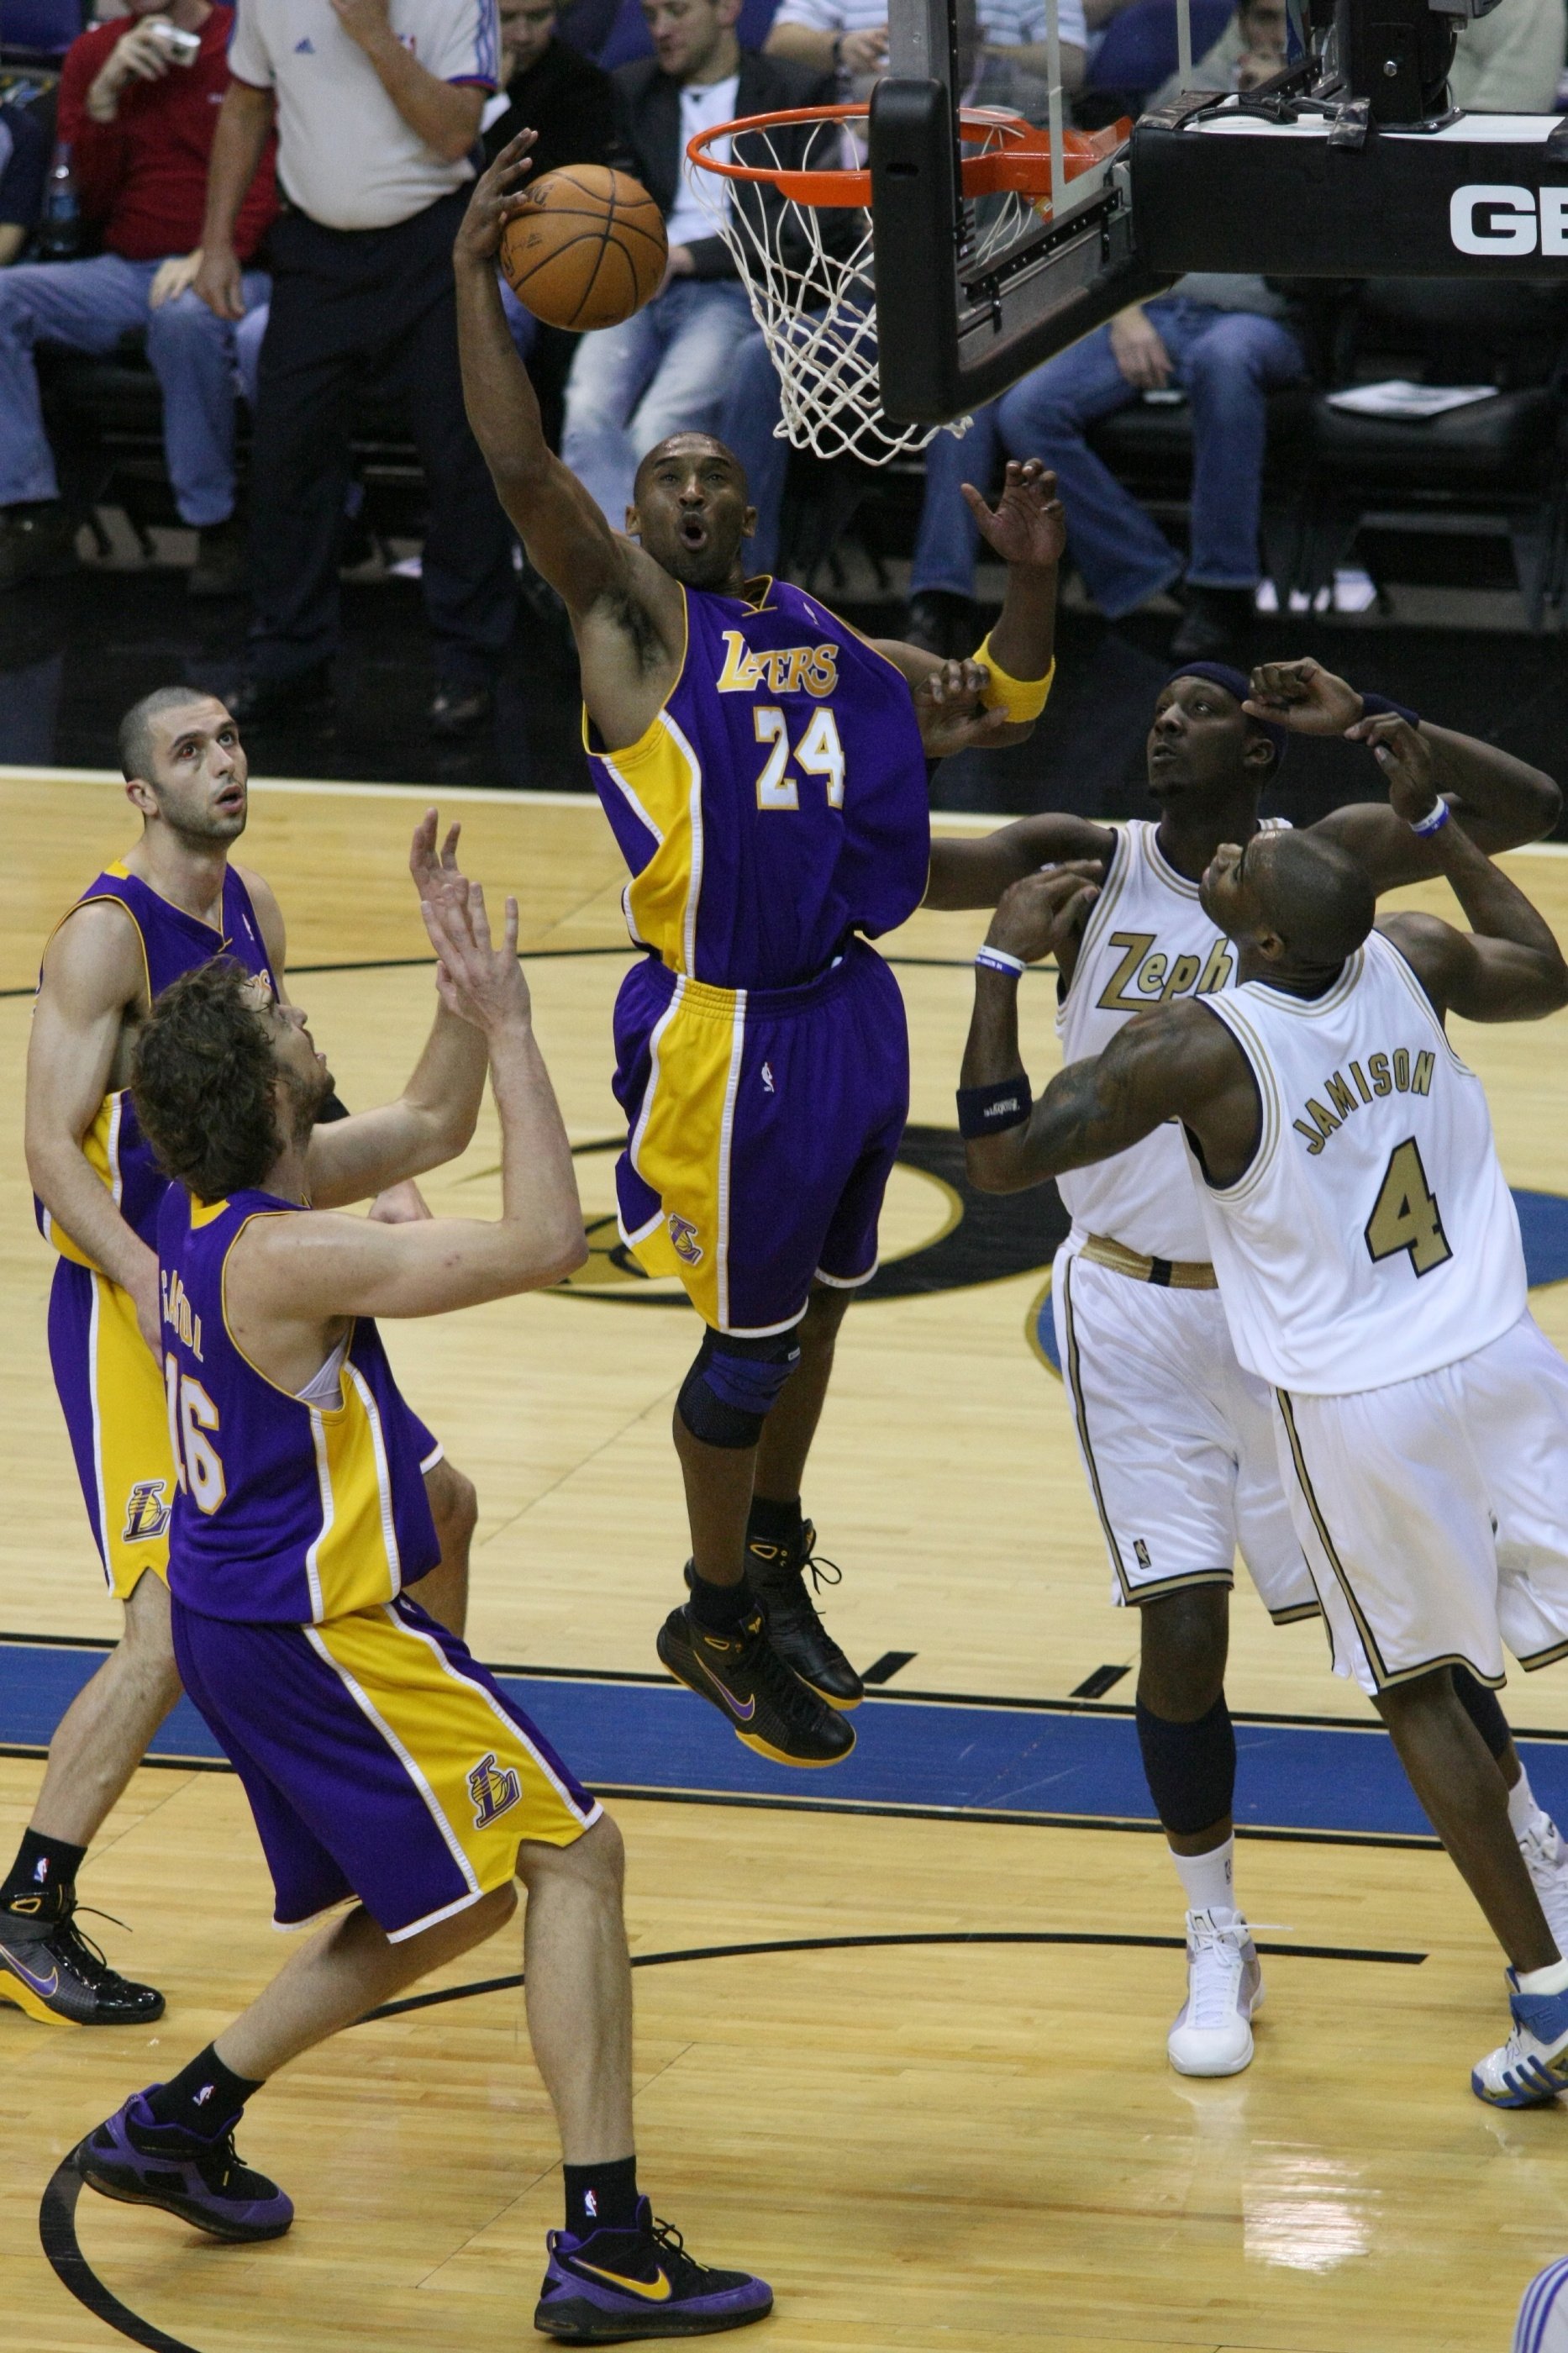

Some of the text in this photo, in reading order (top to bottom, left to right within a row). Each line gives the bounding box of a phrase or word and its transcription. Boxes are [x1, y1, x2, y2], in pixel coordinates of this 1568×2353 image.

[753, 706, 846, 810] 24
[1096, 931, 1234, 1011] Zeph
[1292, 1047, 1435, 1155] JAMISON
[1364, 1135, 1454, 1279] 4
[166, 1351, 227, 1516] 16
